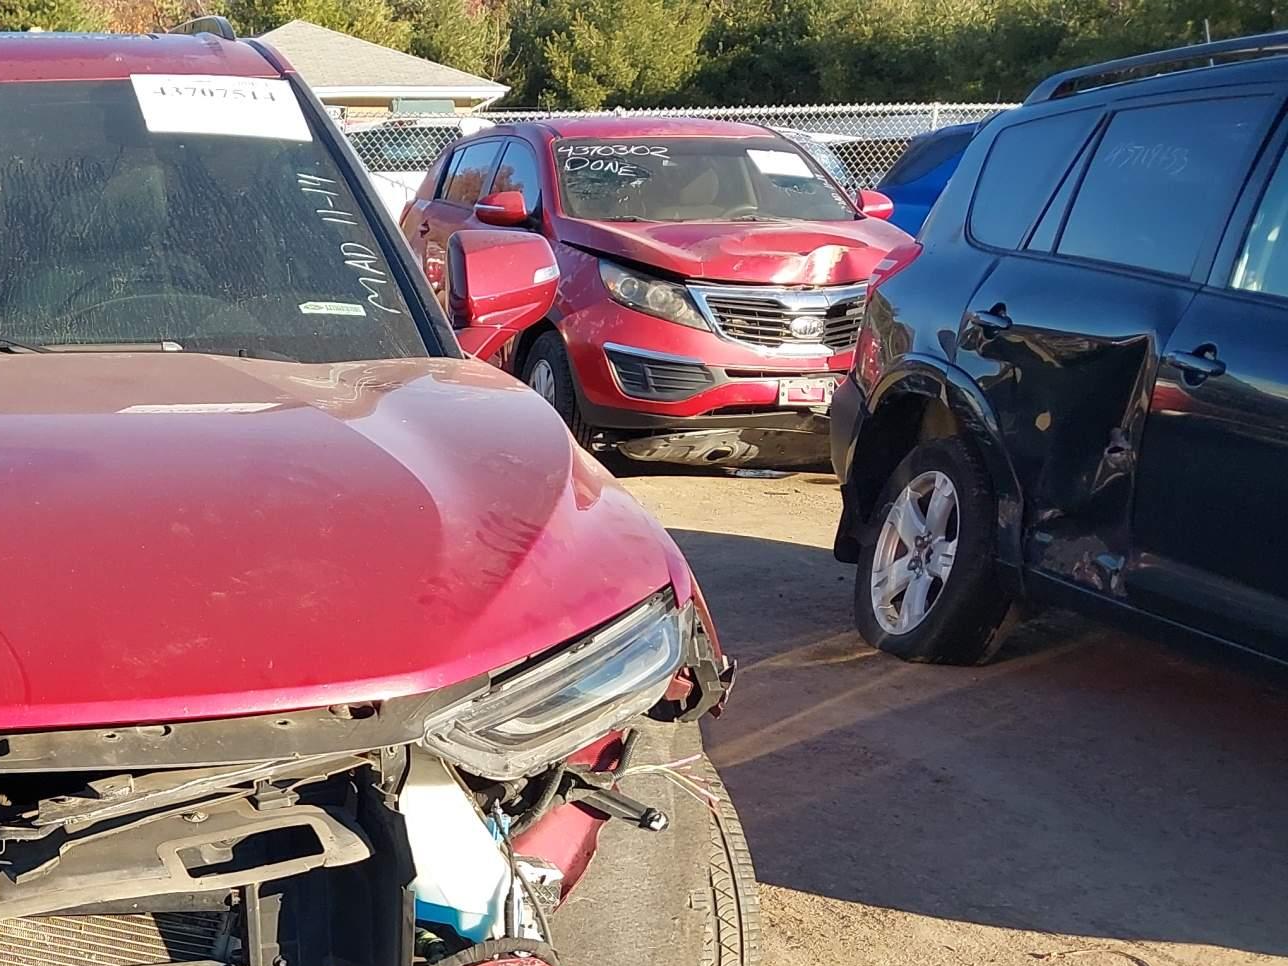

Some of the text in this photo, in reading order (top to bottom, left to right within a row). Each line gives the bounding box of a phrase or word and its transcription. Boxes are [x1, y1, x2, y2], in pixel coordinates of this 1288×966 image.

[564, 156, 638, 177] DONE
[296, 172, 402, 314] MAD 11-14
